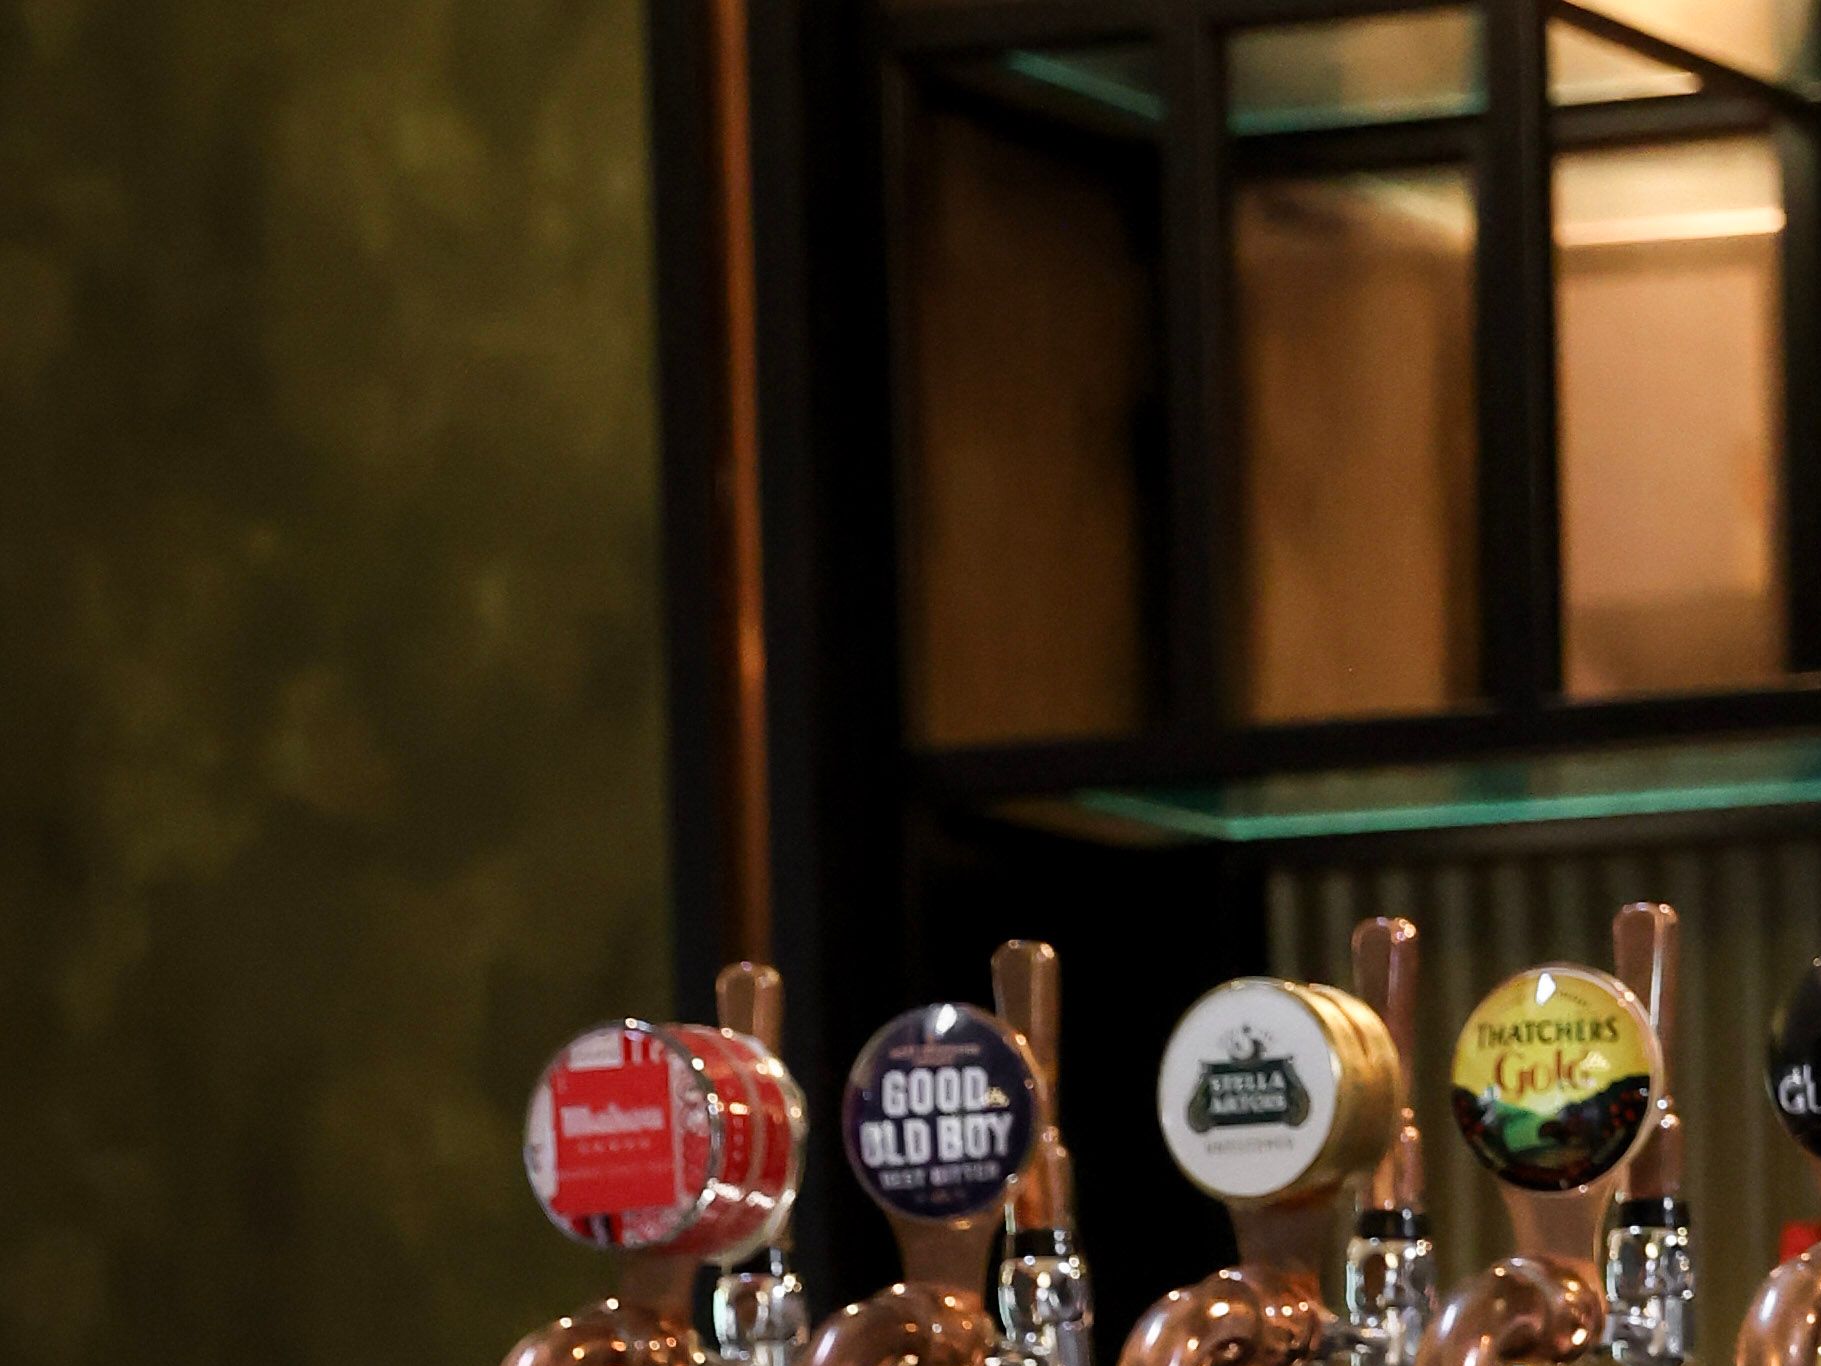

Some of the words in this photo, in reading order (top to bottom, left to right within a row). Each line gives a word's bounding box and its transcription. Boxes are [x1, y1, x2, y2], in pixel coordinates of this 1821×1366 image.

[1477, 1016, 1618, 1049] THATCHERS
[881, 1066, 989, 1119] GOOD
[859, 1117, 932, 1169] OLD
[935, 1111, 1014, 1162] BOY
